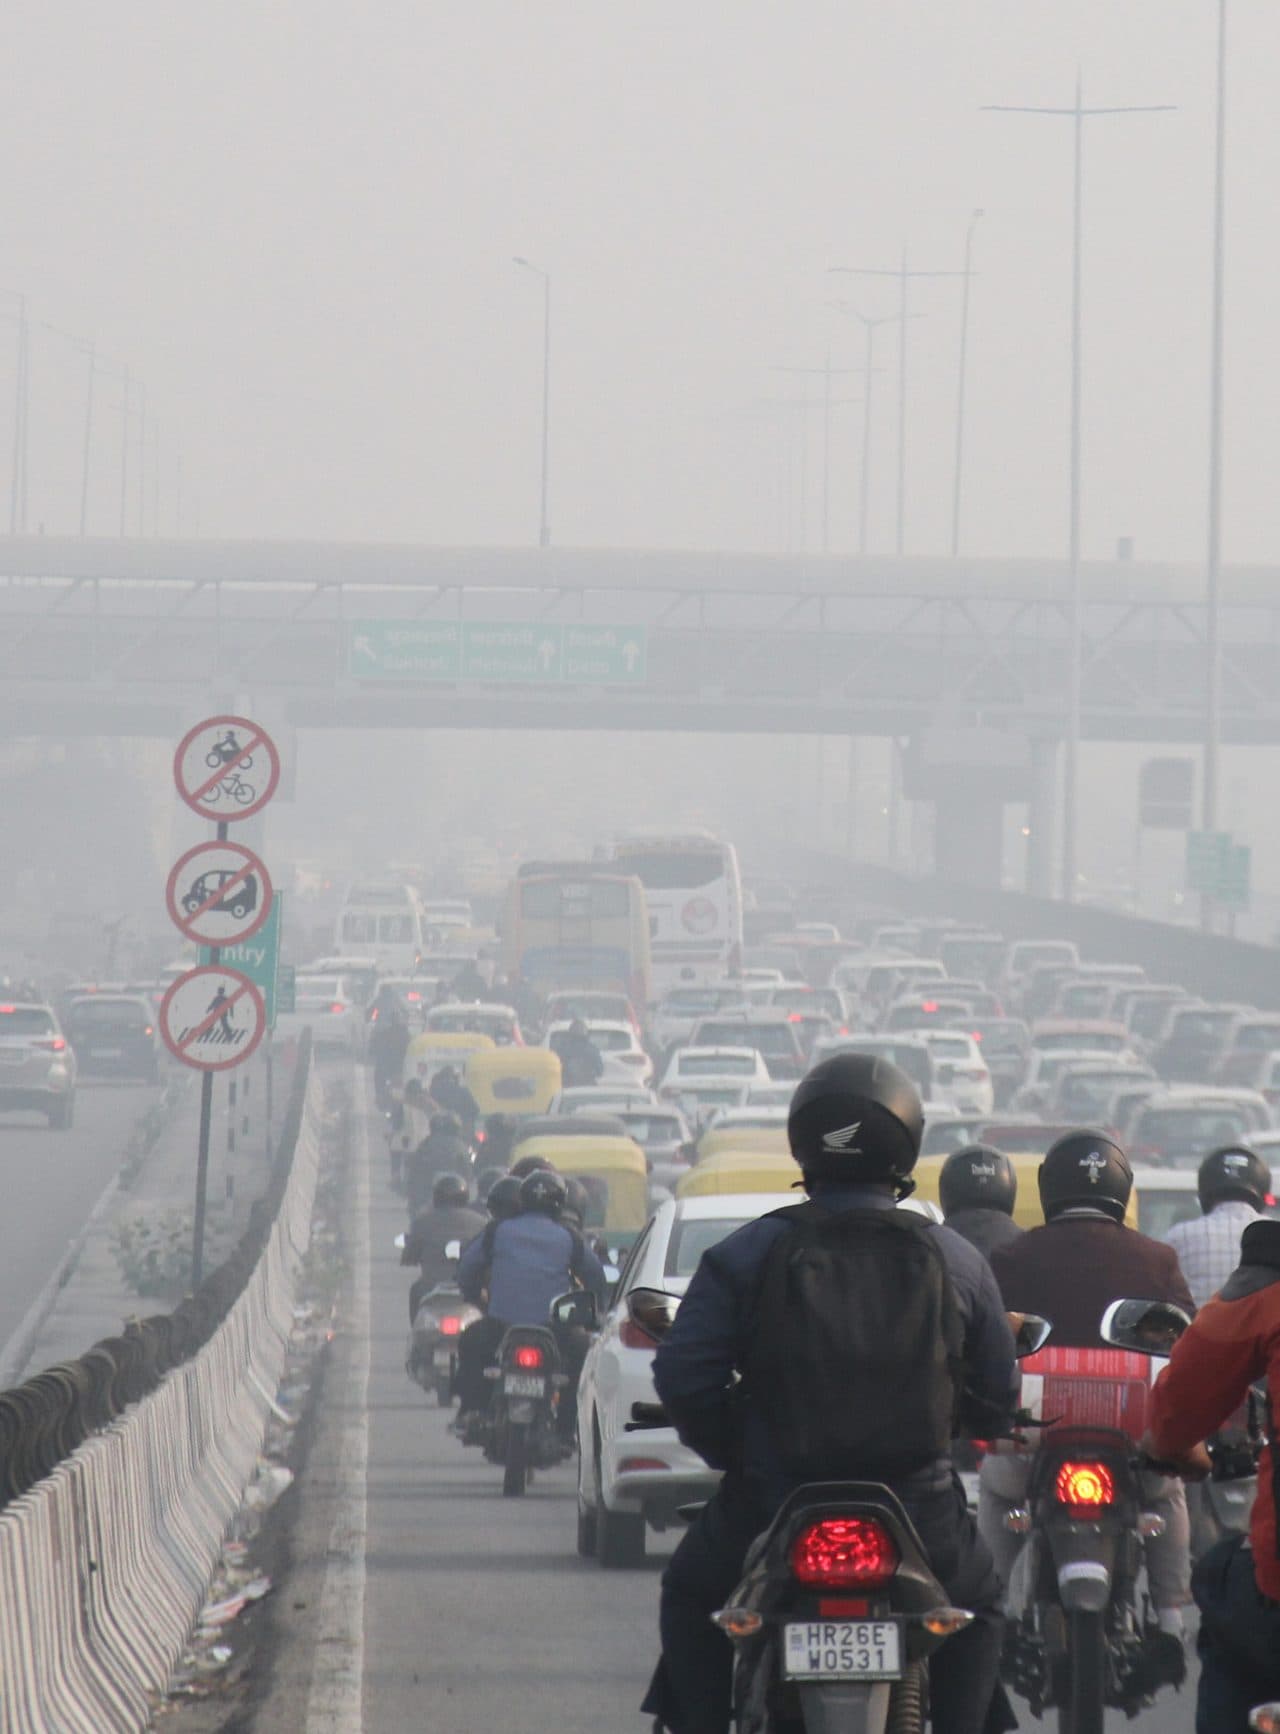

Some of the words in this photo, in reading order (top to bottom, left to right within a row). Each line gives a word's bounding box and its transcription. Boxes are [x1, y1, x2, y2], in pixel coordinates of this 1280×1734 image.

[219, 944, 266, 968] ntry
[807, 1624, 886, 1646] HR26E
[808, 1649, 885, 1670] W0531
